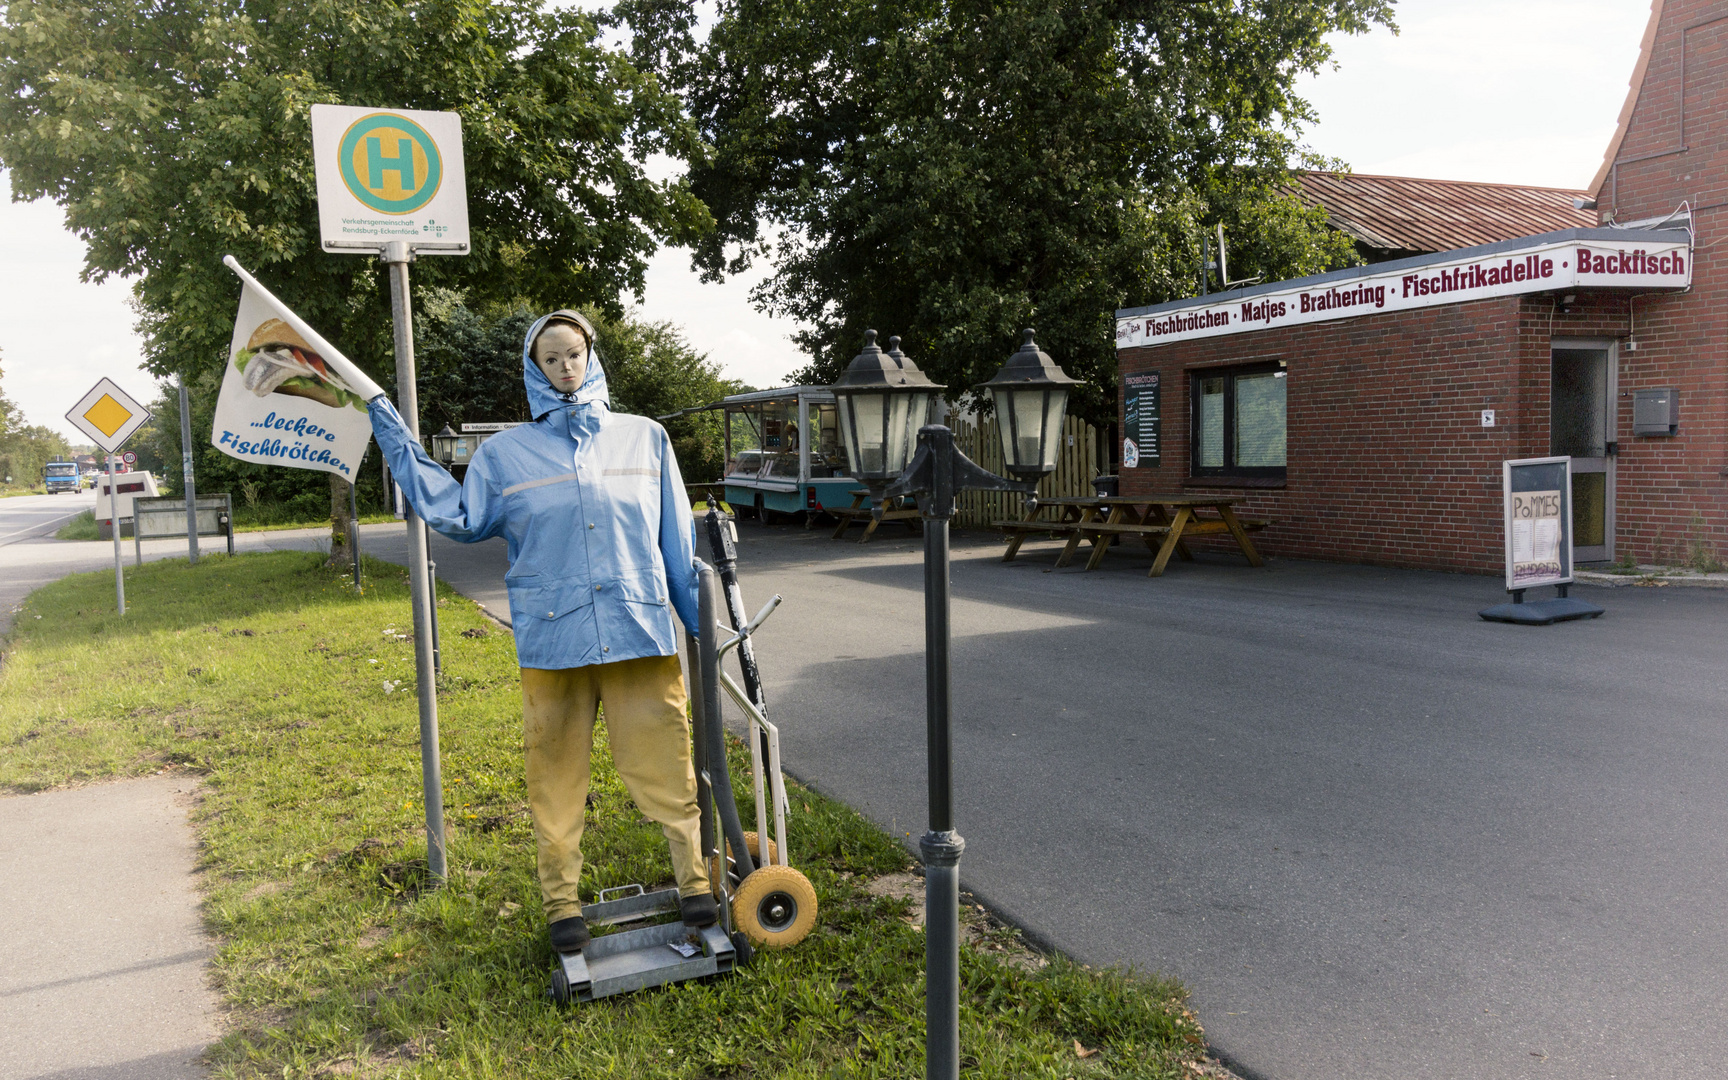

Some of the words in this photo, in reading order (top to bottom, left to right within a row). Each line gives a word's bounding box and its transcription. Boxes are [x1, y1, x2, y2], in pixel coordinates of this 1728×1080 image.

[366, 137, 415, 191] H
[341, 217, 415, 226] Verkehrsgemeinschaft
[342, 226, 419, 235] Rendsburg-Eckernförde
[1577, 248, 1685, 275] Backfisch
[1145, 309, 1229, 337] Fischbrötchen
[1241, 298, 1286, 324] Matjes
[1300, 283, 1385, 309] Brathering
[1402, 254, 1554, 298] Fischfrikadelle
[219, 430, 350, 475] Fischbrötchen
